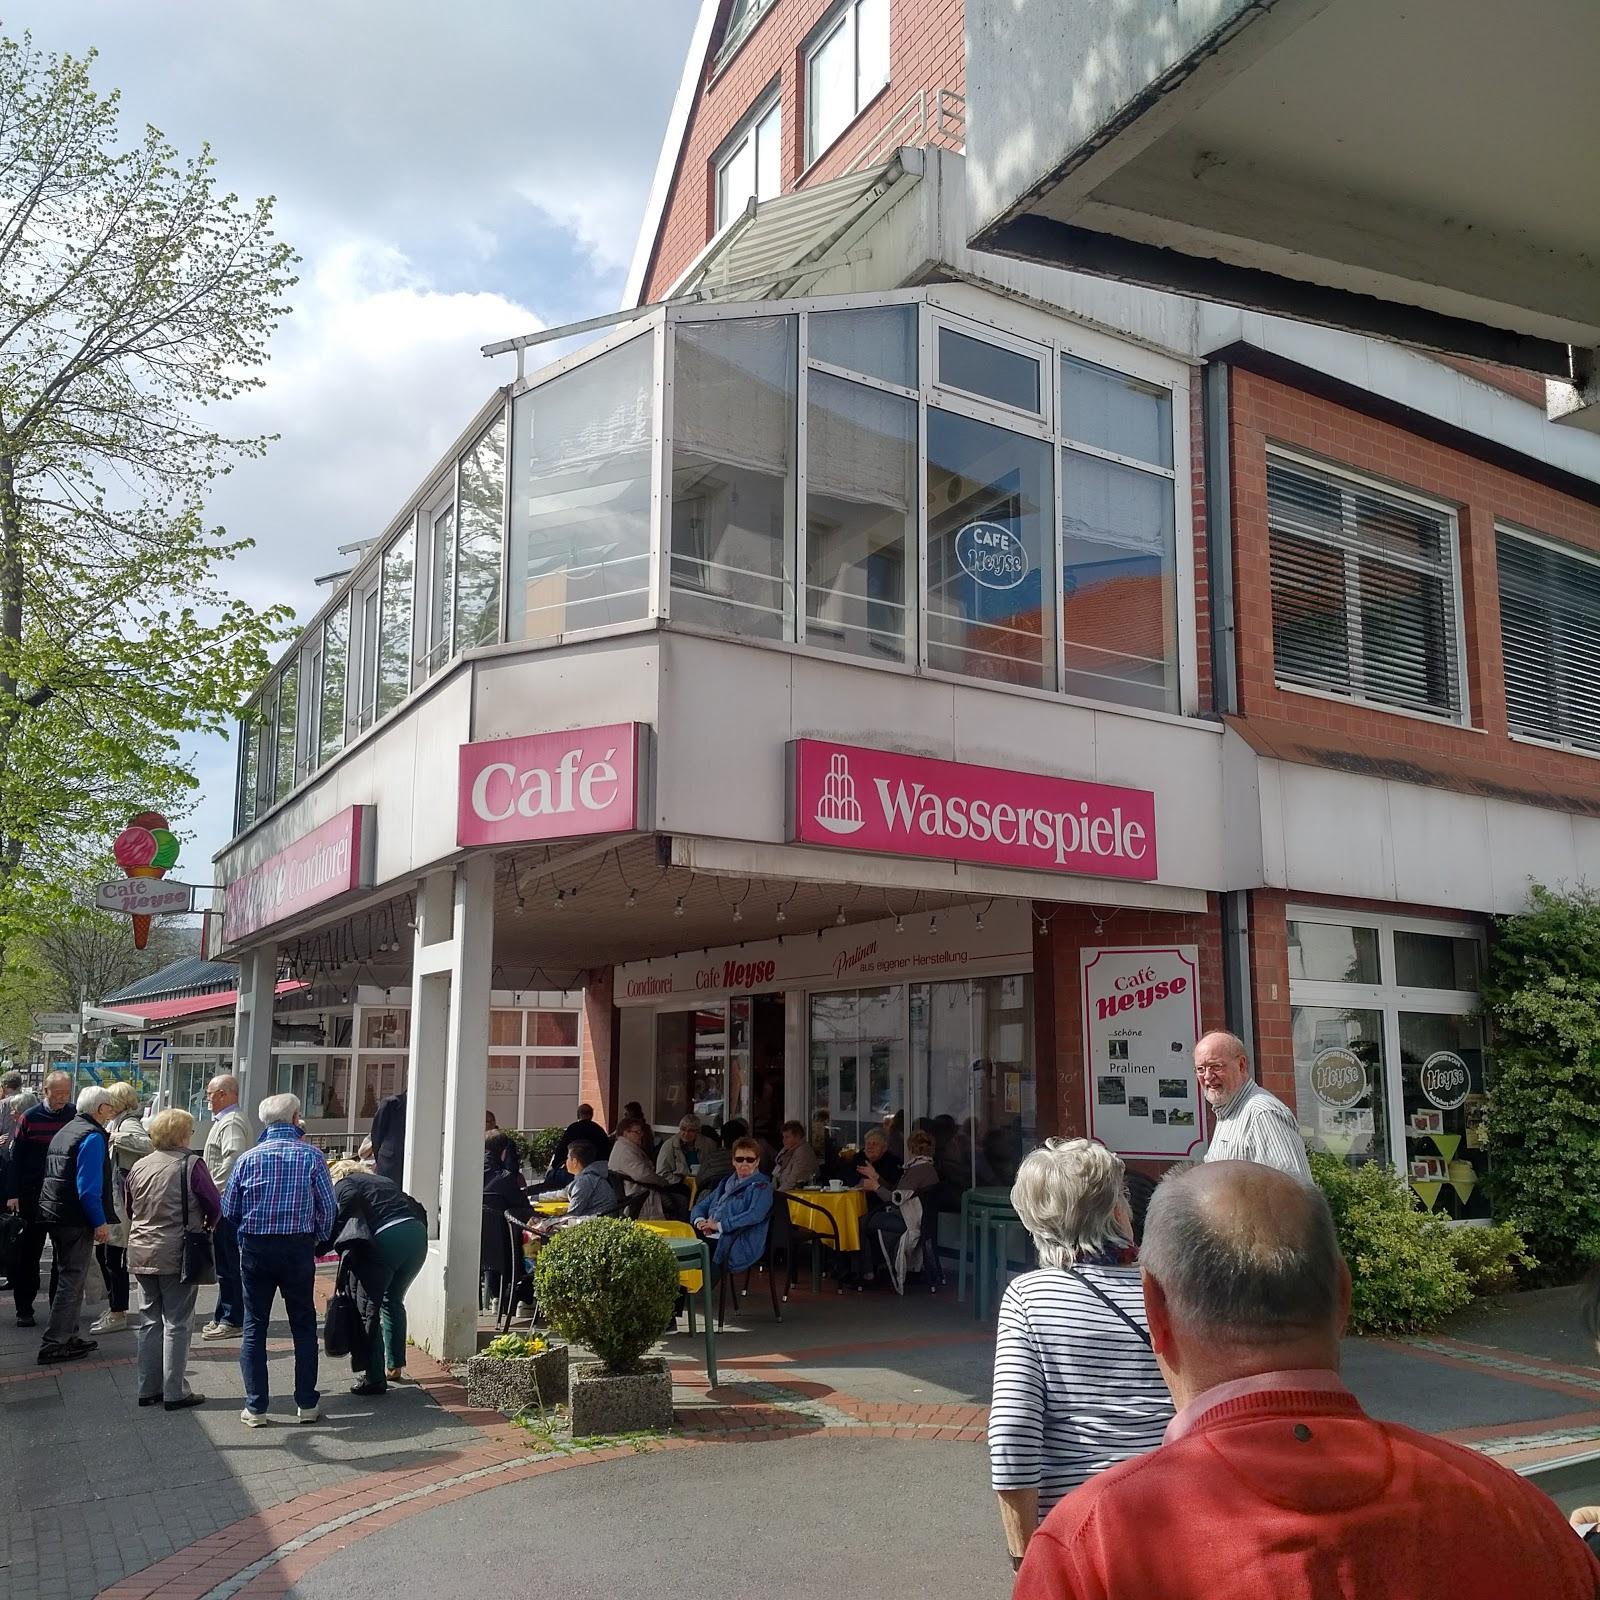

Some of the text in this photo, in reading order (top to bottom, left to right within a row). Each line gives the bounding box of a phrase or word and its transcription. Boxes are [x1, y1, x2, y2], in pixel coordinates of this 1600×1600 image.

[973, 528, 1009, 551] CAFE
[967, 549, 1022, 577] Heyse
[471, 748, 619, 823] Café
[873, 778, 1147, 865] Wasserspiele
[287, 824, 350, 901] Conditorei
[103, 881, 148, 899] Café
[121, 891, 187, 911] Heyse
[832, 940, 878, 979] Pralinen
[859, 951, 968, 973] aus eigener Herstellung
[626, 960, 776, 998] Conditorei Cafe Heyse
[1114, 966, 1157, 991] Café
[1096, 977, 1187, 1021] Heyse
[1109, 1063, 1155, 1074] Pralinen
[1317, 1066, 1360, 1089] Heyse
[1427, 1069, 1465, 1091] Heyse
